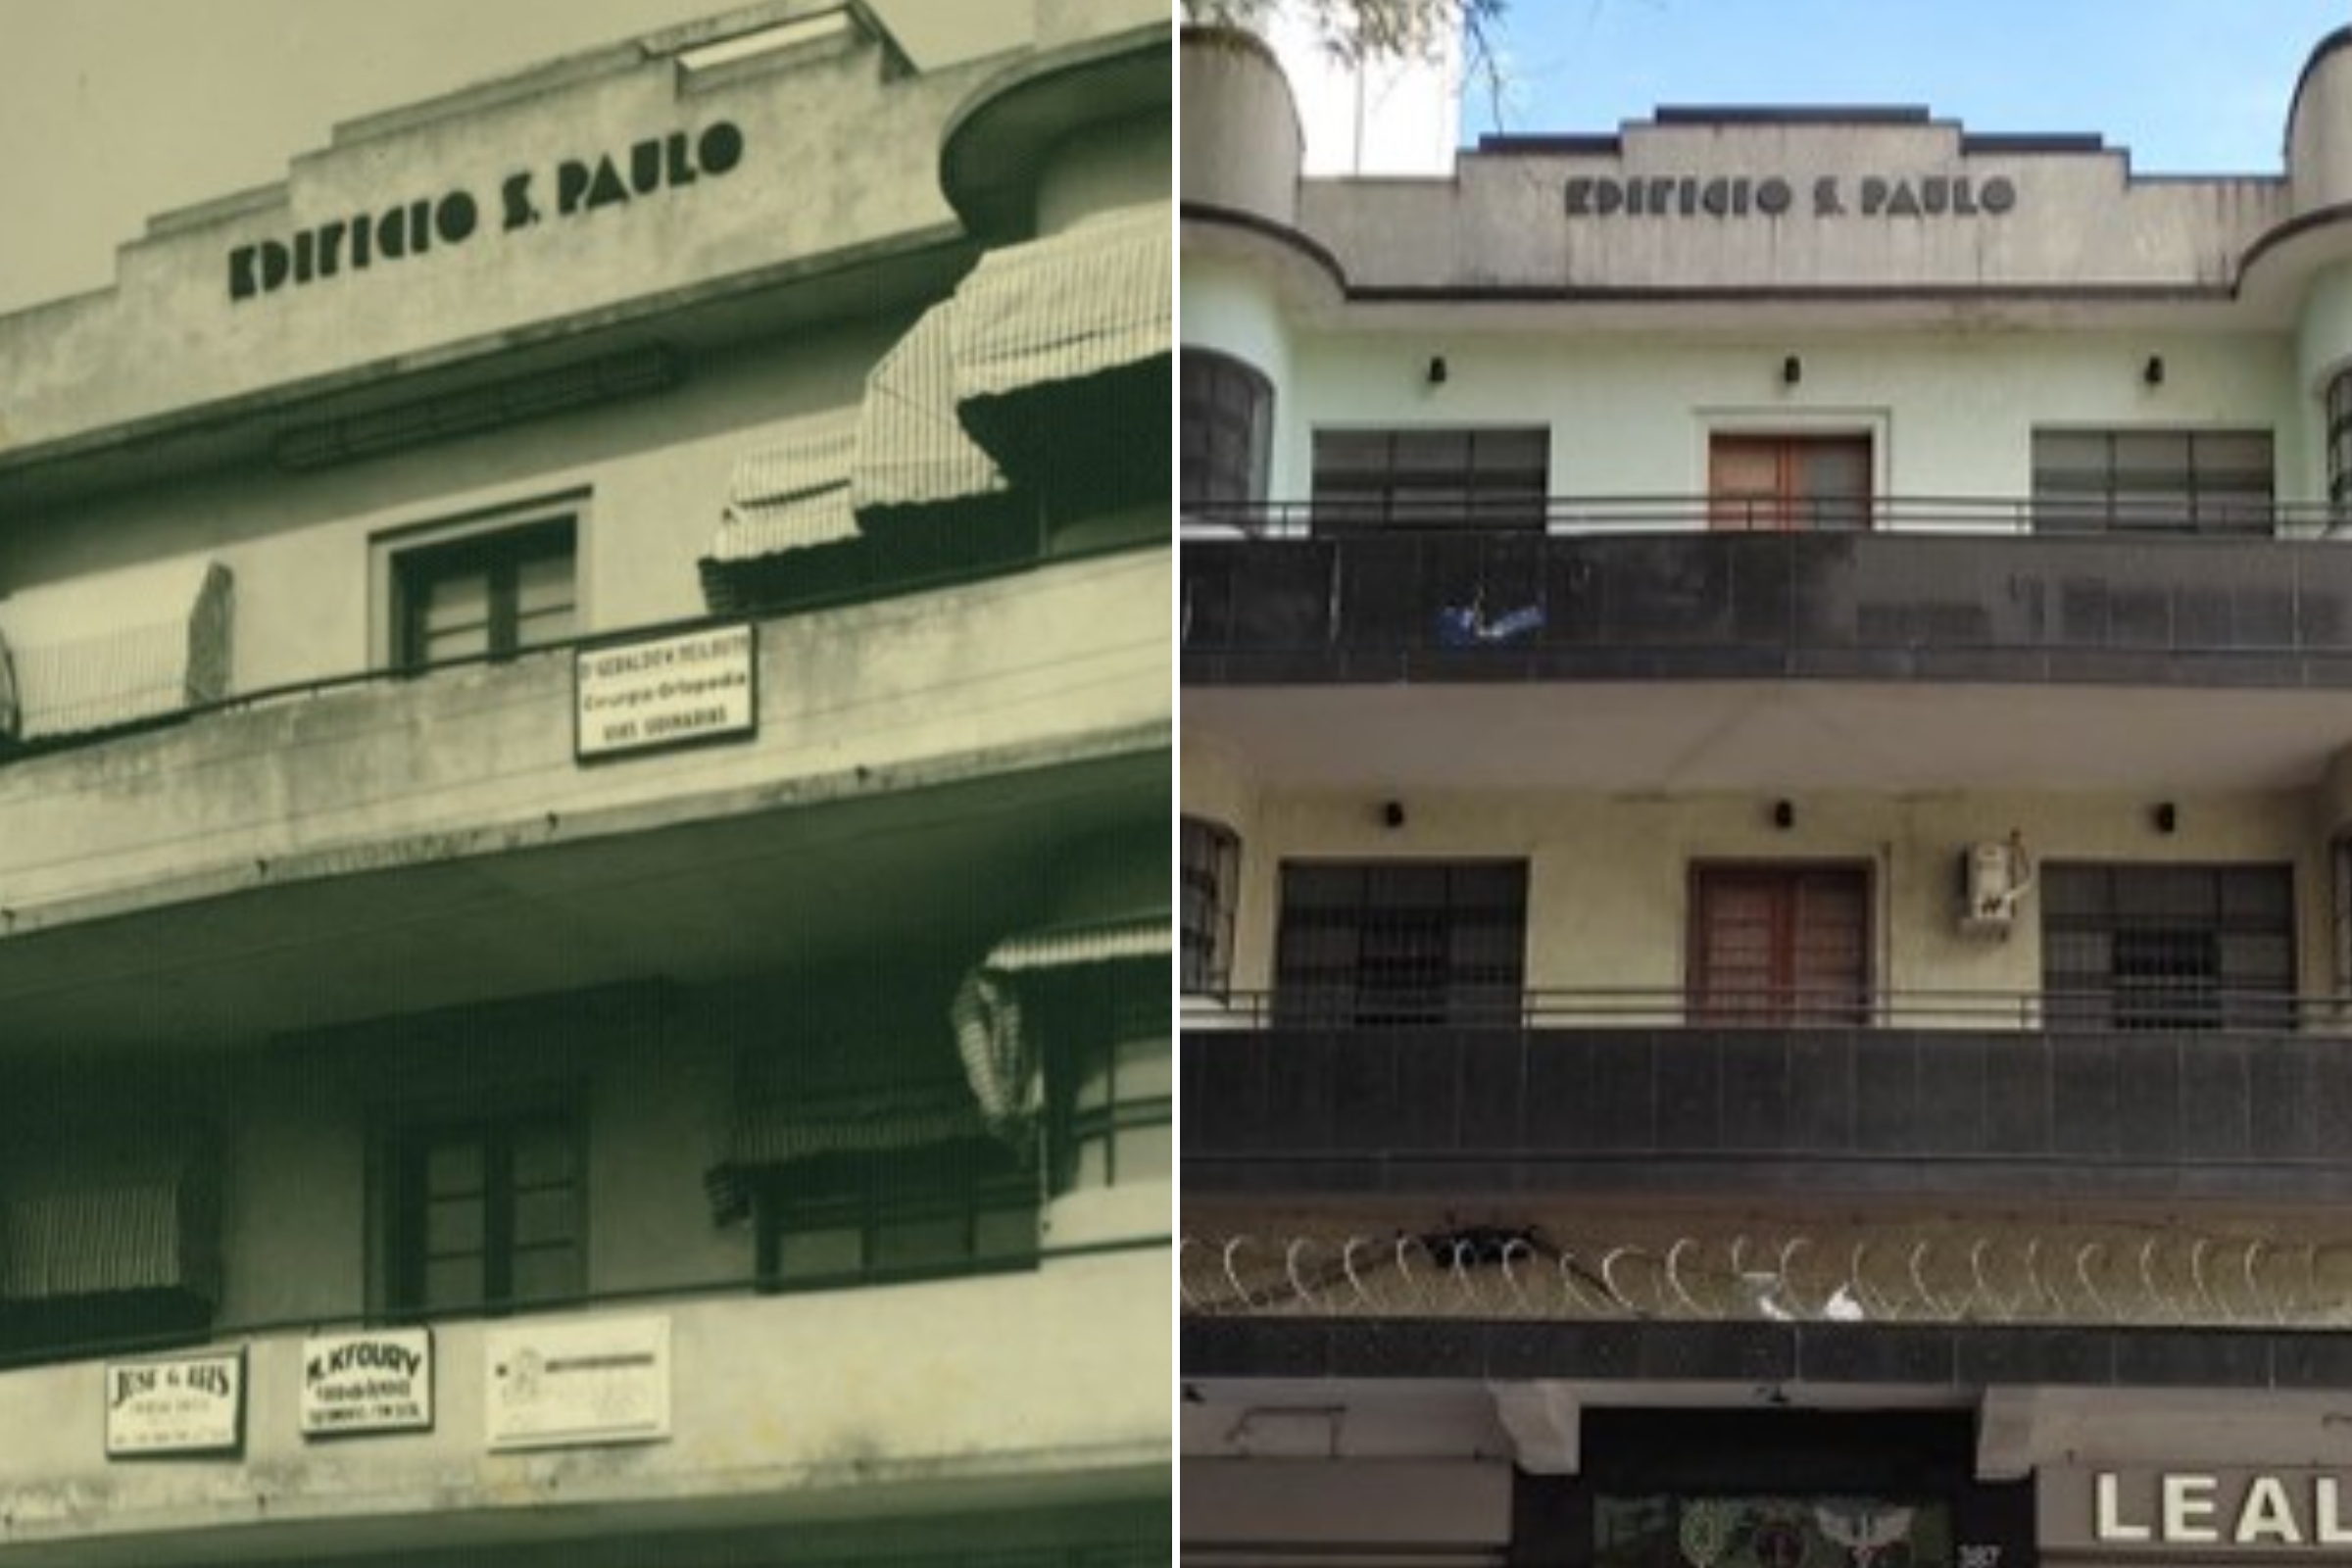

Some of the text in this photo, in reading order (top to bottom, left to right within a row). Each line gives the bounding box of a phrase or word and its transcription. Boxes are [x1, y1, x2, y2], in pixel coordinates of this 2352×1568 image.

[228, 120, 744, 302] EDIFICIO S. PAULO
[1564, 175, 1792, 219] EDIFICIO
[1861, 174, 2017, 220] PAULO
[2097, 1472, 2352, 1544] LEAL
